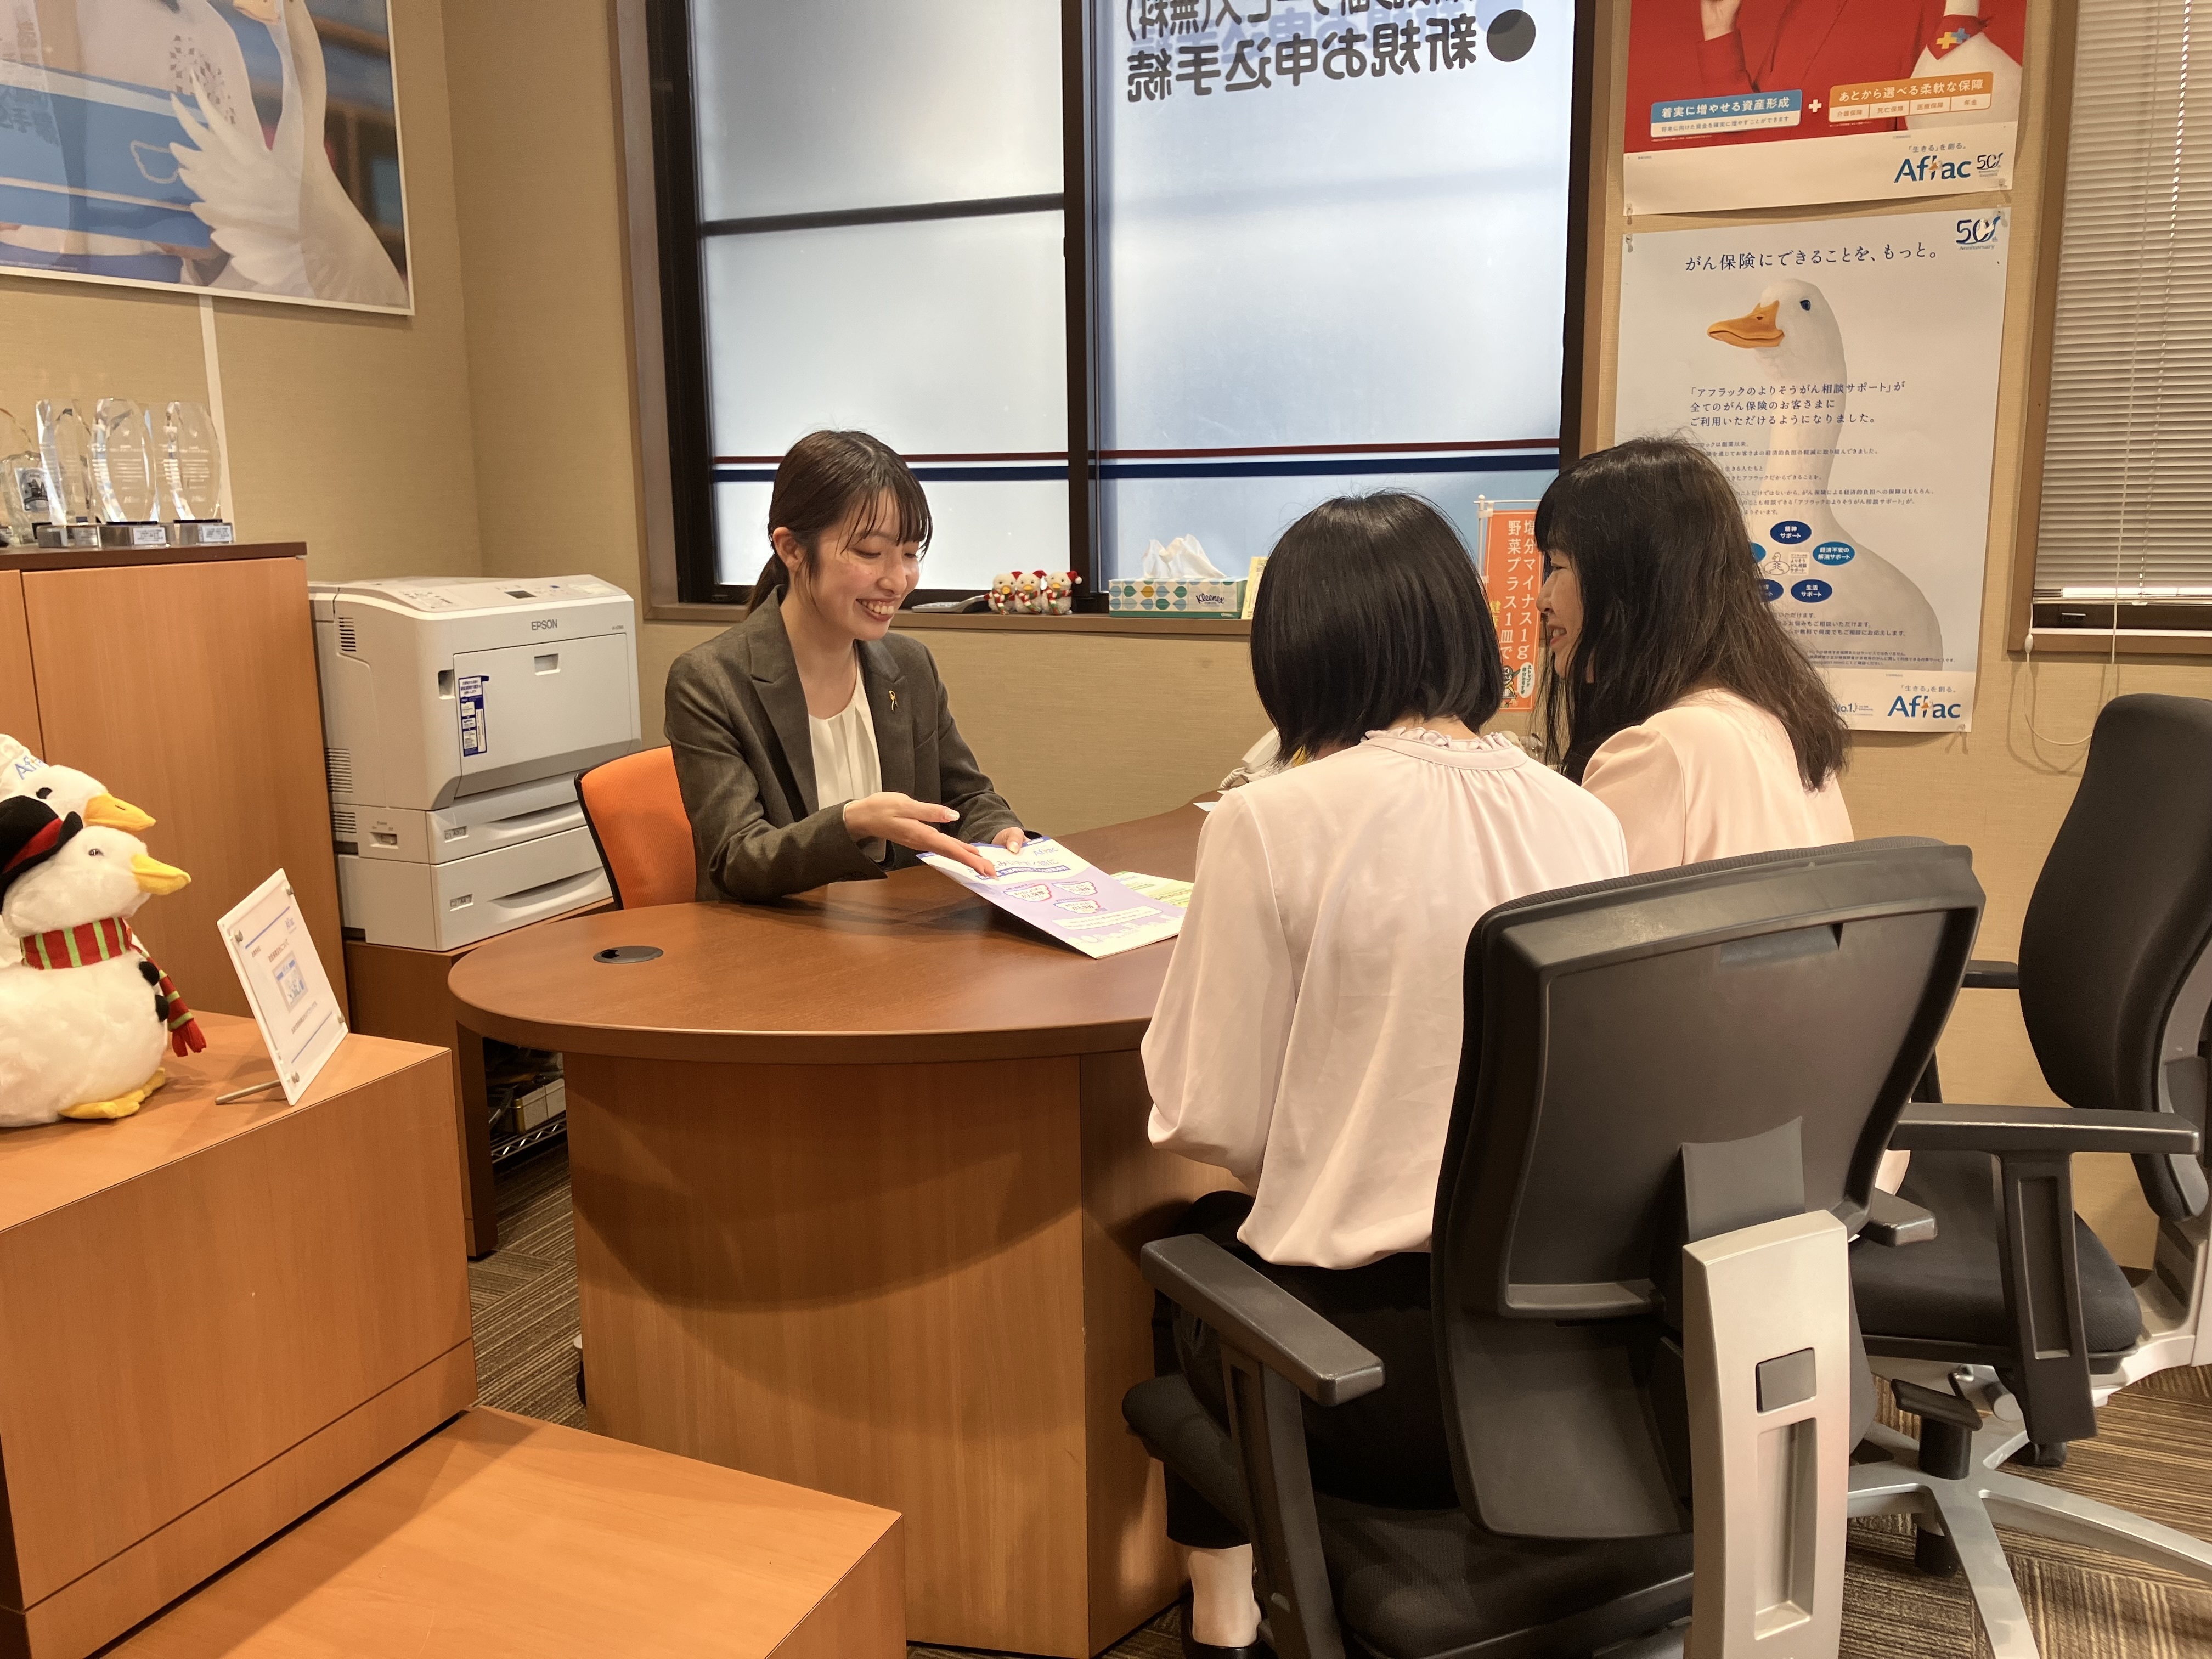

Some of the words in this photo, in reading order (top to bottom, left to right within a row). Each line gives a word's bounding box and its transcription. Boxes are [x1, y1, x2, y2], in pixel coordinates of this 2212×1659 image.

[1839, 78, 1984, 103] あとから選べる柔軟な保障
[1661, 97, 1790, 119] 着実に増やせる資産形成
[1894, 155, 1972, 184] Aflac
[1685, 241, 1937, 272] がん保険にできることを、もっと。
[1691, 380, 1906, 397] 「アフラックのよりそうがん相談サポート」が
[1690, 399, 1836, 413] 全てのがん保険のお客さまに
[1690, 413, 1876, 427] ご利用いただけるようになりました。
[1195, 592, 1225, 604] Kleenex
[531, 619, 558, 631] EPSON
[1887, 695, 1961, 719] Aflac
